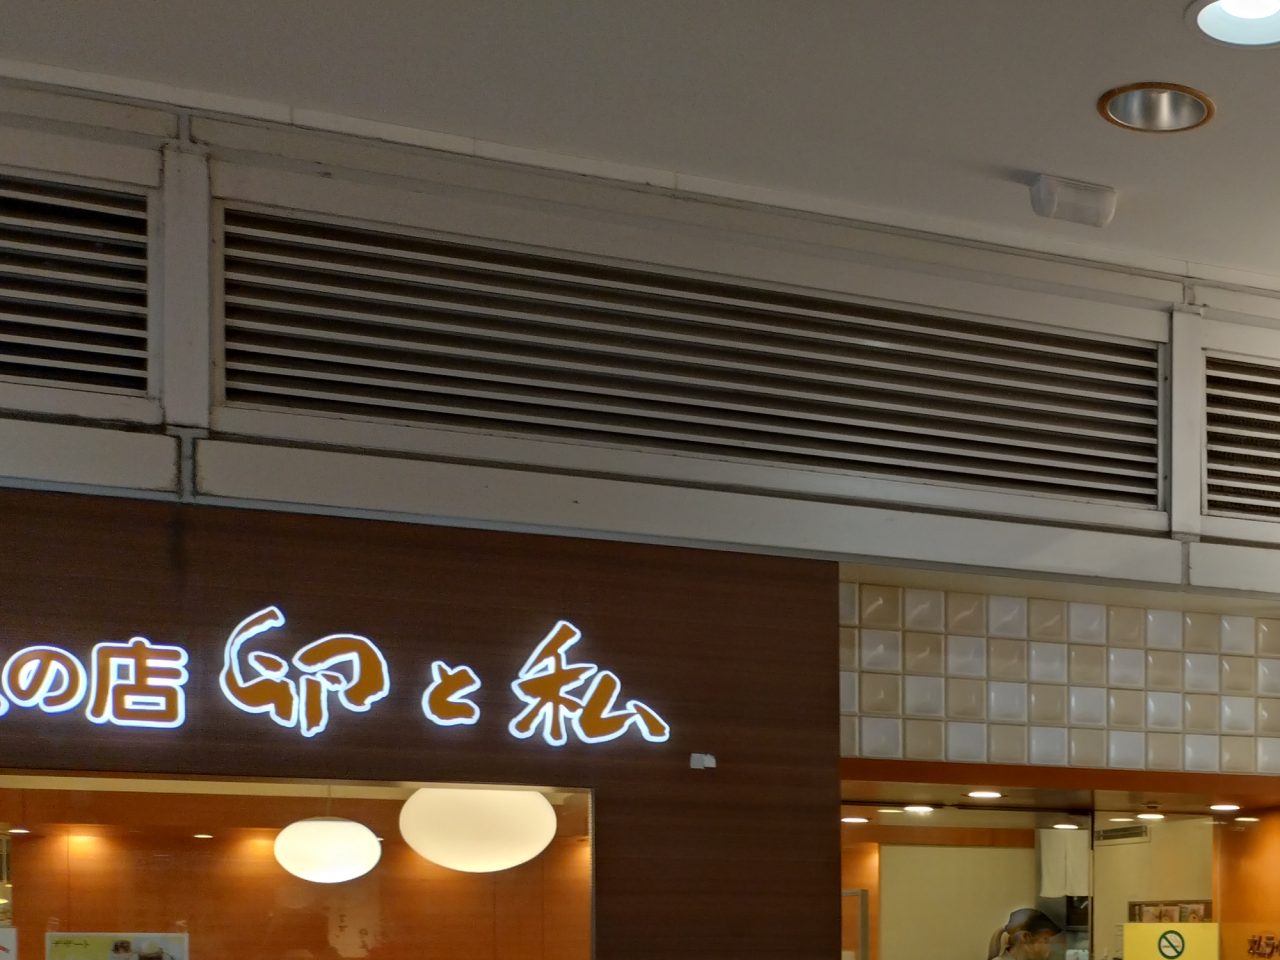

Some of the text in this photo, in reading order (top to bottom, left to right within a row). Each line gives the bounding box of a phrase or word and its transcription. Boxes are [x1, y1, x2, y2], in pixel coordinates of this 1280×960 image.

[0, 606, 670, 746] の店 卵と私
